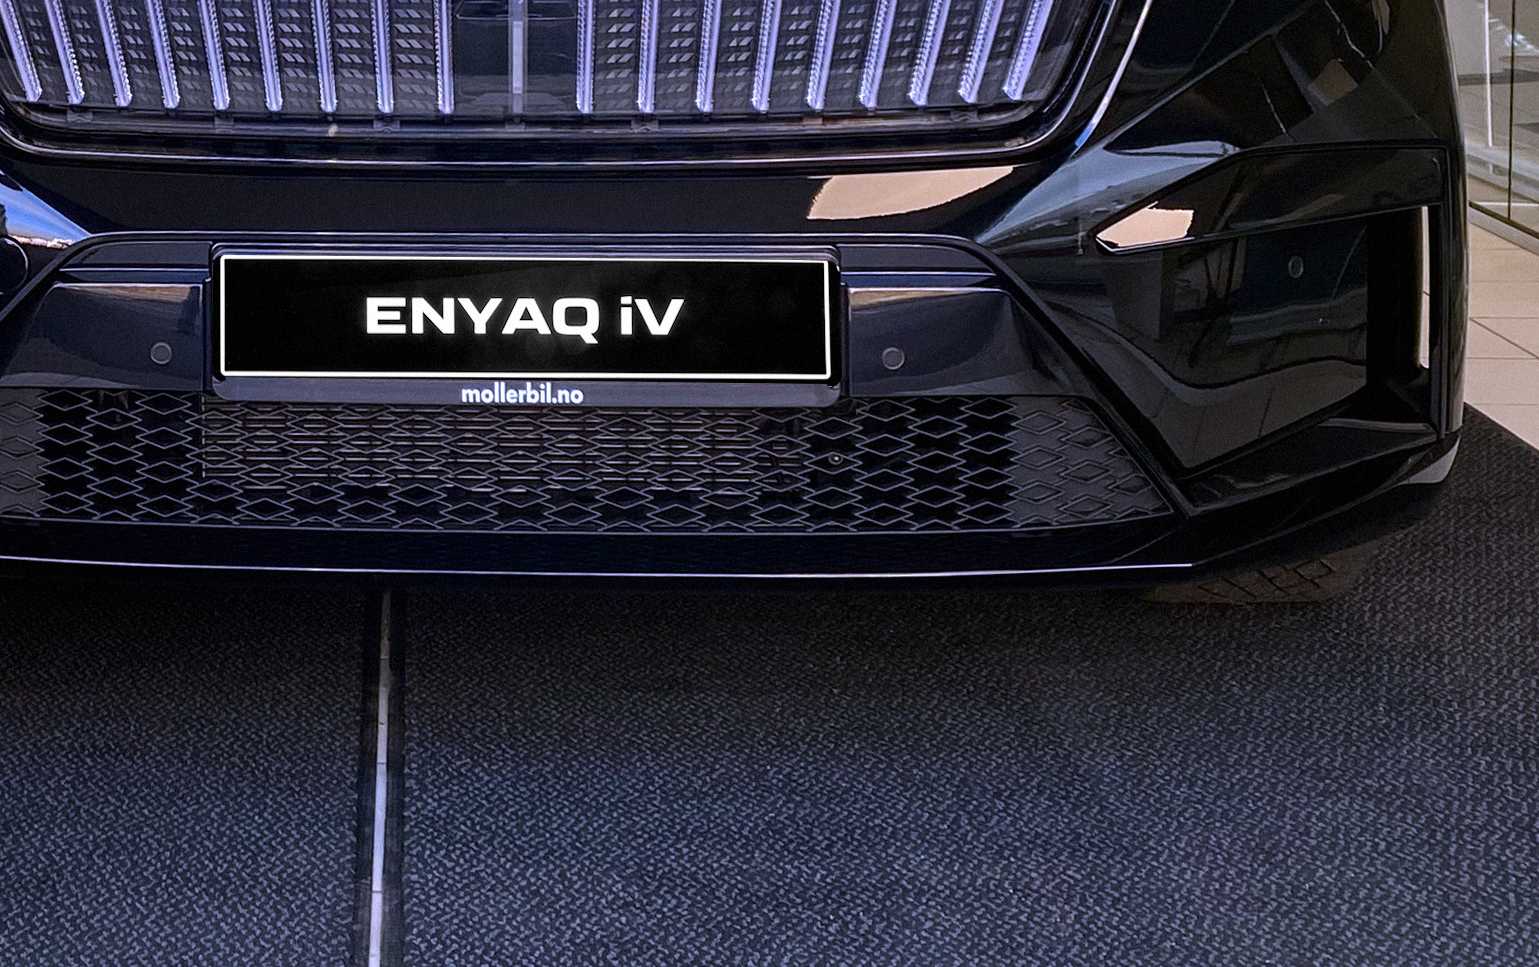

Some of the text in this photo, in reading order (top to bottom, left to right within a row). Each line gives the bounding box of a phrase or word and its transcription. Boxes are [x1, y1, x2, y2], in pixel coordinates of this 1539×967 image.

[365, 295, 685, 344] ENYAQ iV
[461, 382, 584, 404] mollerbil.no
